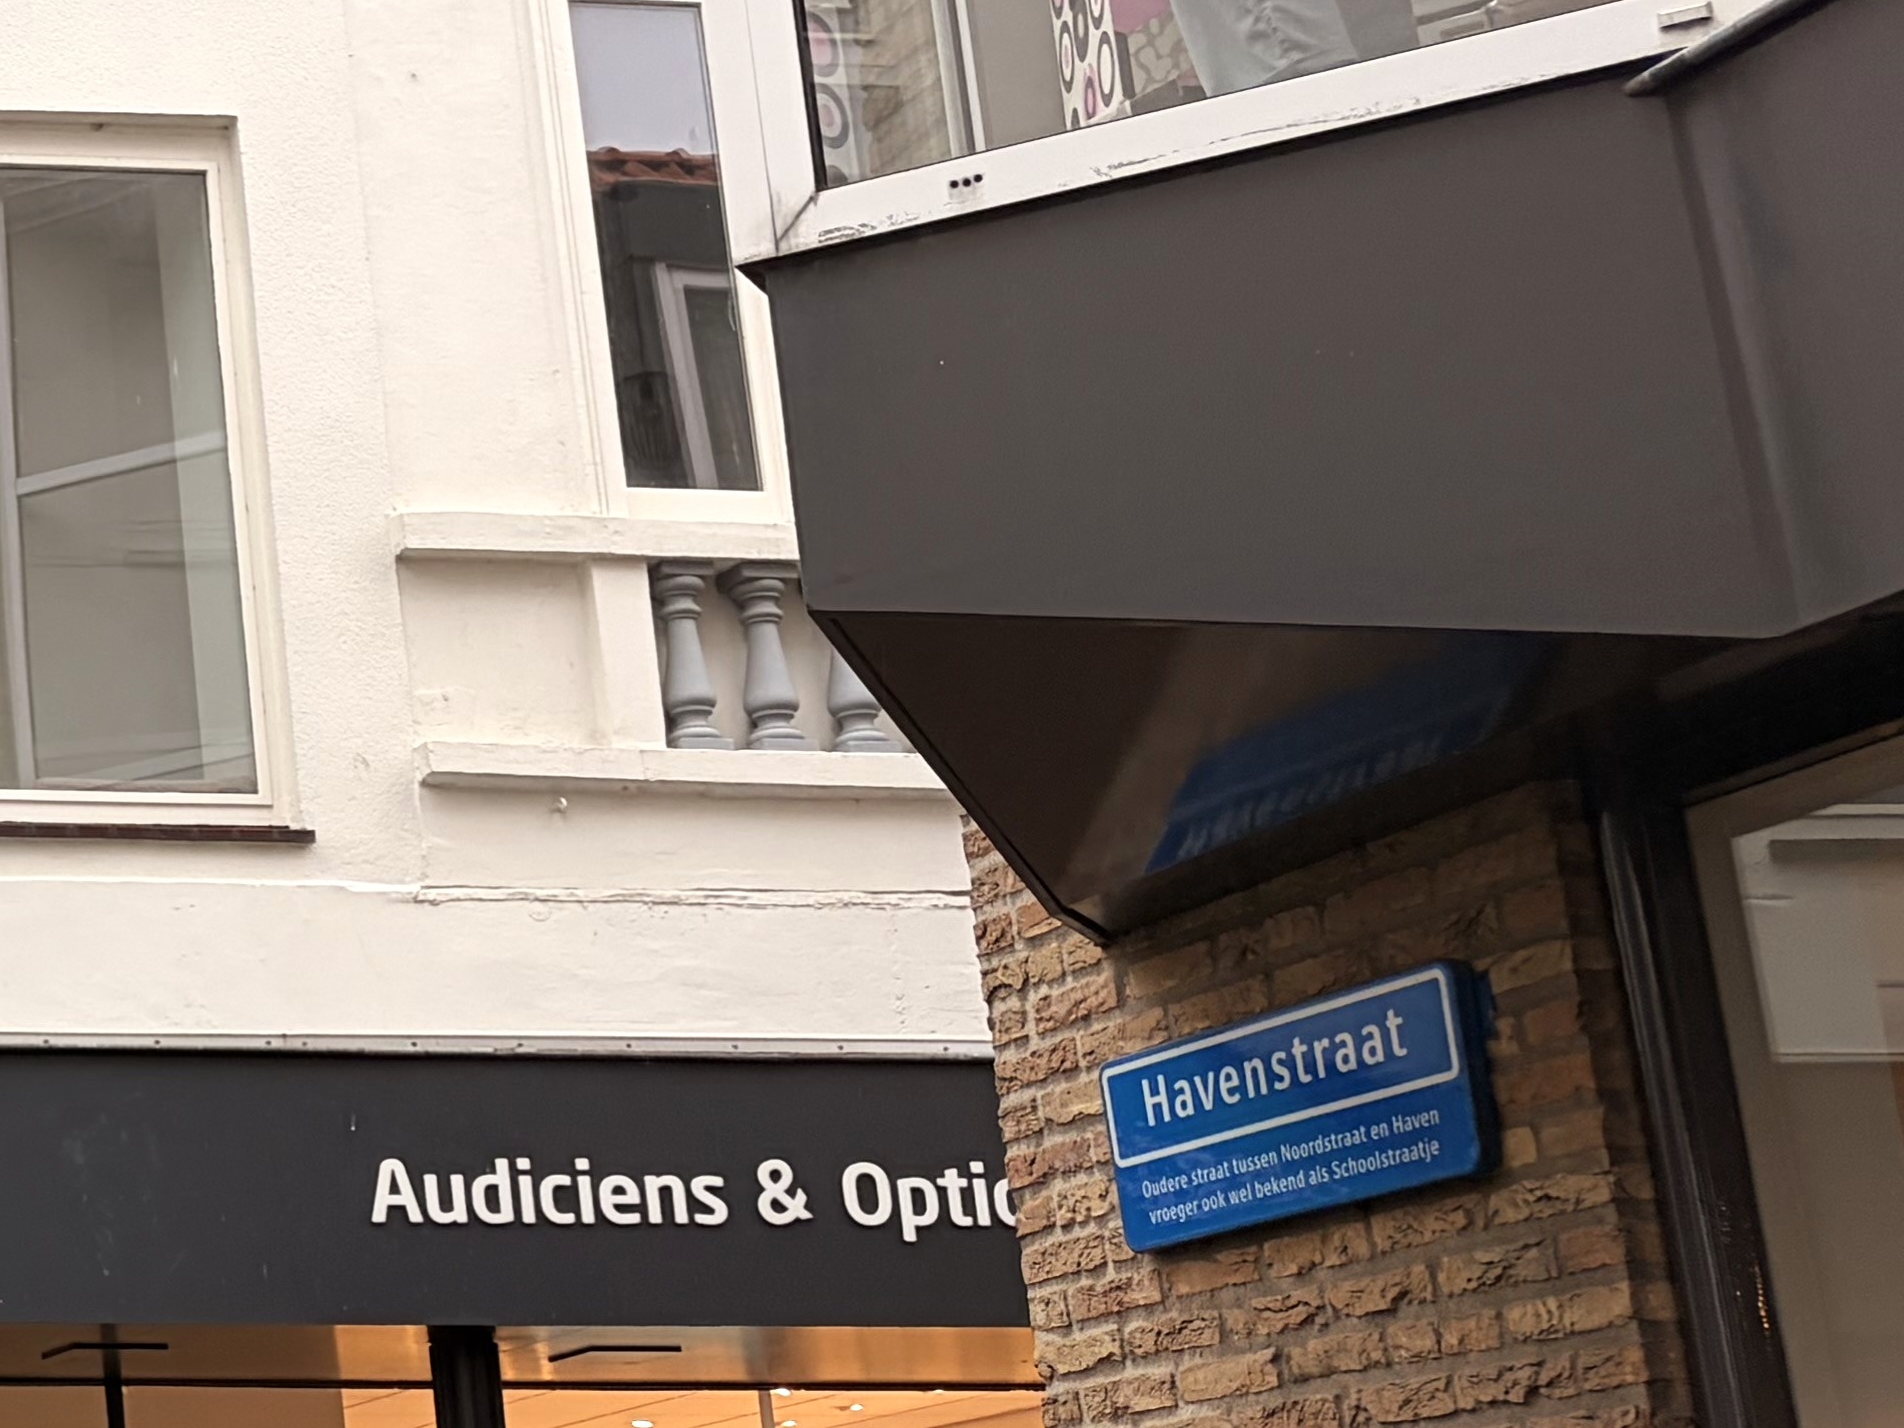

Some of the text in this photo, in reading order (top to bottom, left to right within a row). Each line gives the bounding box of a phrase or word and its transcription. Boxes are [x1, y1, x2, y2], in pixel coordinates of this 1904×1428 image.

[1140, 1008, 1409, 1128] Havenstraat
[370, 1156, 730, 1226] Audiciens
[756, 1158, 814, 1226] &
[1142, 1109, 1440, 1199] Oudere straat tussen Noordstraat en Haven
[1148, 1138, 1440, 1225] vroeger ook wel bekend als Schoolstraatje
